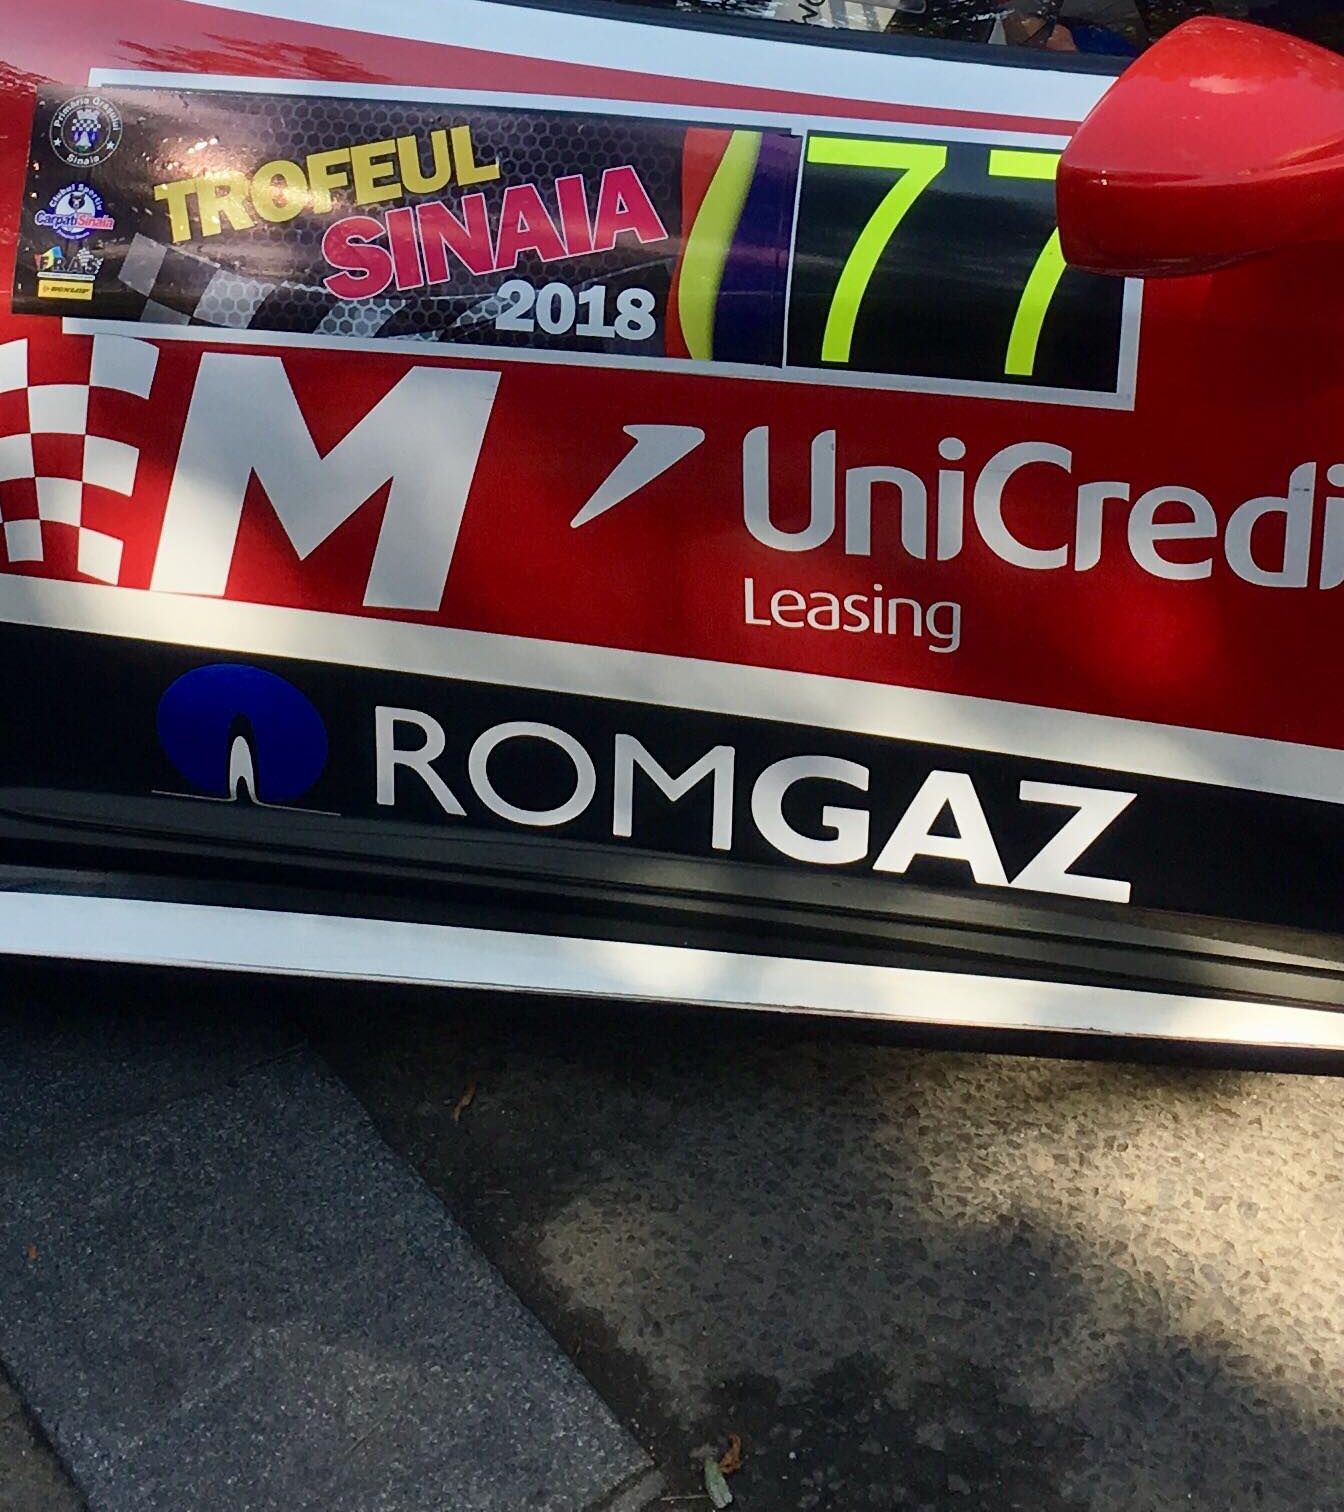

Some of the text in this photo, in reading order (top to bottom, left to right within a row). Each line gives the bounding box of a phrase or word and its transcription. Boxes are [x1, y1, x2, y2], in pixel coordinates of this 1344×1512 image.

[154, 125, 500, 244] TROFEUL
[321, 165, 669, 300] SINAIA
[494, 279, 656, 341] 2018
[745, 577, 961, 653] Leasing
[374, 705, 1137, 903] ROMGAZ
